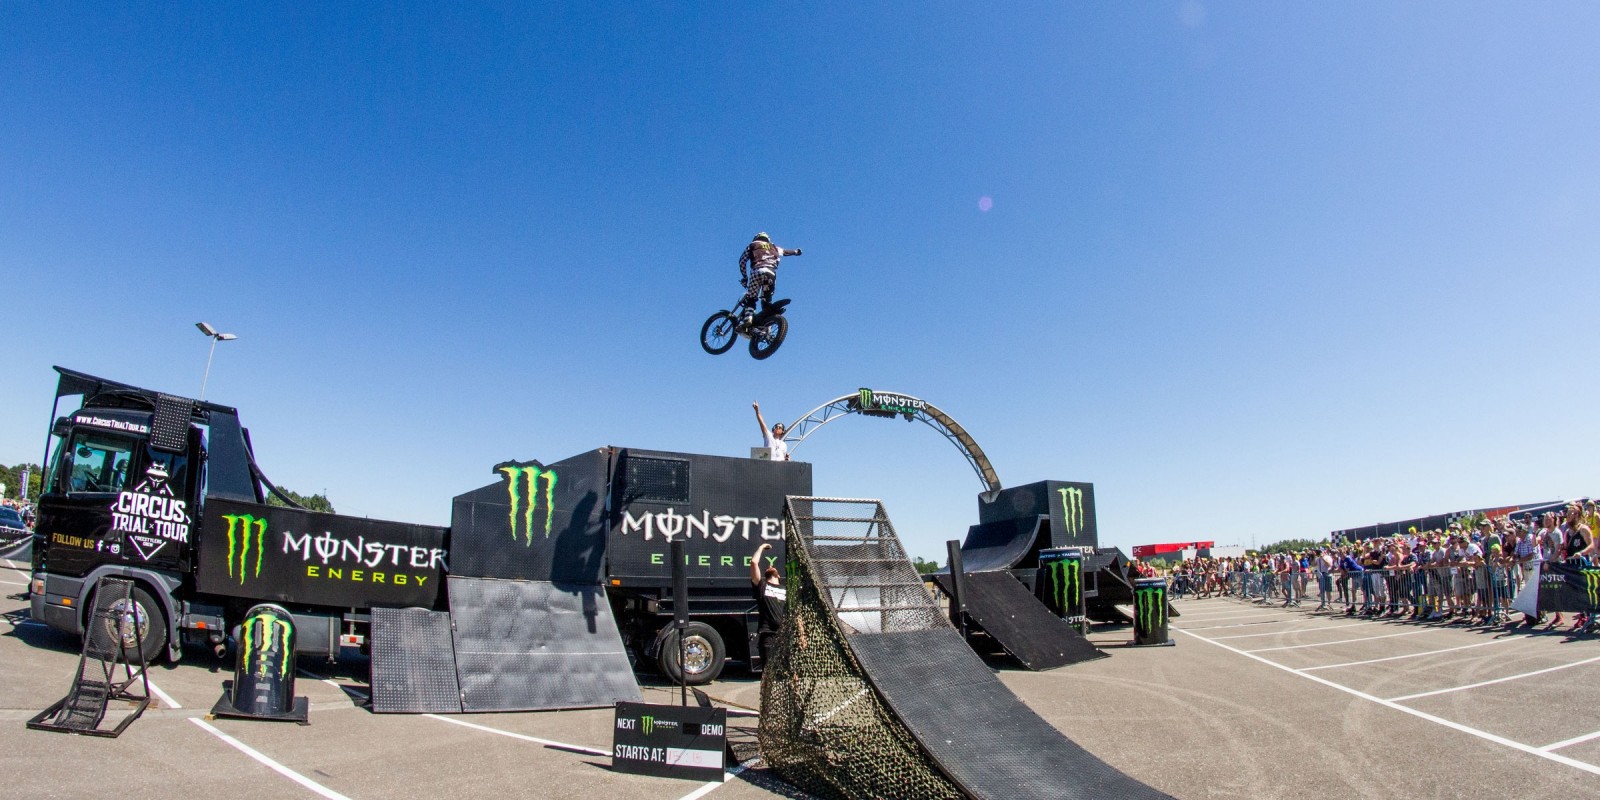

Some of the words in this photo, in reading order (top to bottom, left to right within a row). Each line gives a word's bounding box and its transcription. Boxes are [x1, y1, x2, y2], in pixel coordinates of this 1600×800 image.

[873, 394, 926, 410] MONSTER
[118, 491, 186, 523] CIRCUS
[112, 512, 149, 534] TRIAL
[154, 519, 189, 543] TOUR
[620, 507, 786, 543] MONSTE
[52, 532, 82, 547] FOLLOW
[83, 538, 95, 549] US
[283, 530, 449, 573] MONSTER
[651, 553, 778, 567] EERGY
[307, 565, 428, 586] ENERGY
[617, 718, 636, 730] NEXT
[701, 724, 723, 736] DEMO
[615, 744, 649, 760] STARTS
[650, 748, 665, 762] AT:
